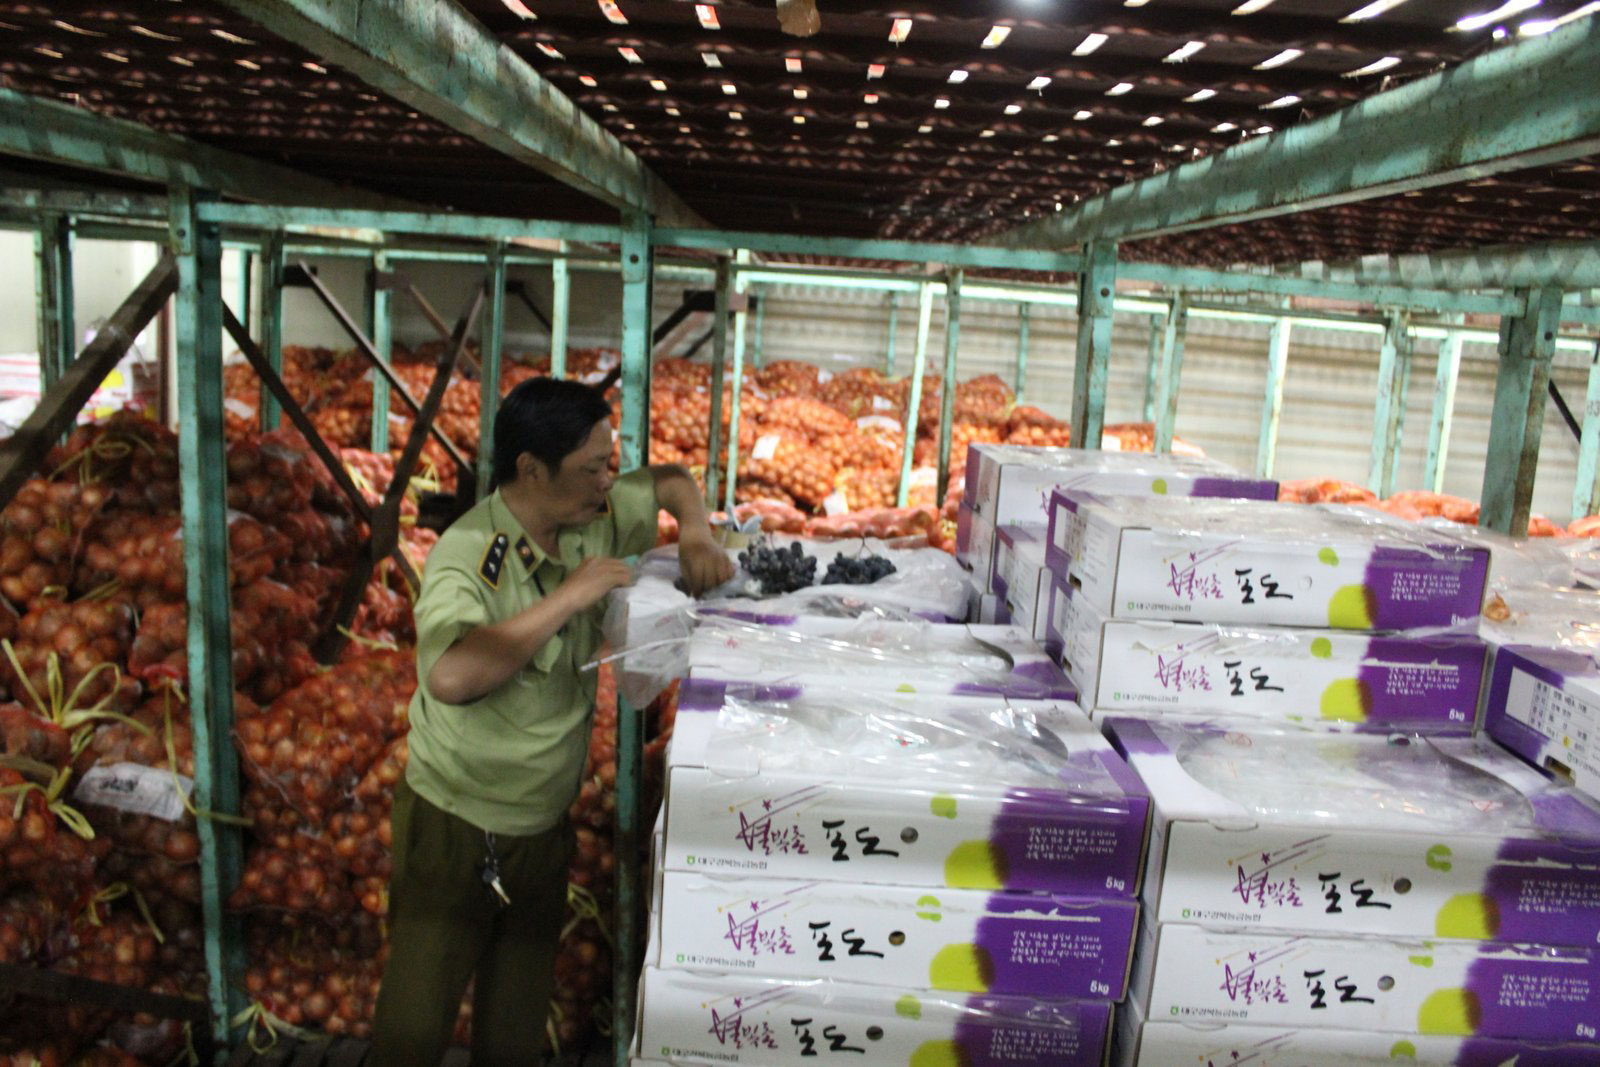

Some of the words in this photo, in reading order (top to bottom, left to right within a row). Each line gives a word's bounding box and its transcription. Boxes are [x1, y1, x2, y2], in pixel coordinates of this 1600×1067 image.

[1235, 569, 1293, 604] 포도
[1224, 661, 1284, 696] 포도
[822, 820, 899, 861] 포도
[1318, 872, 1391, 913] 포도
[809, 922, 884, 961] 포도
[1304, 970, 1374, 1009] 포도
[791, 1018, 865, 1056] 포도
